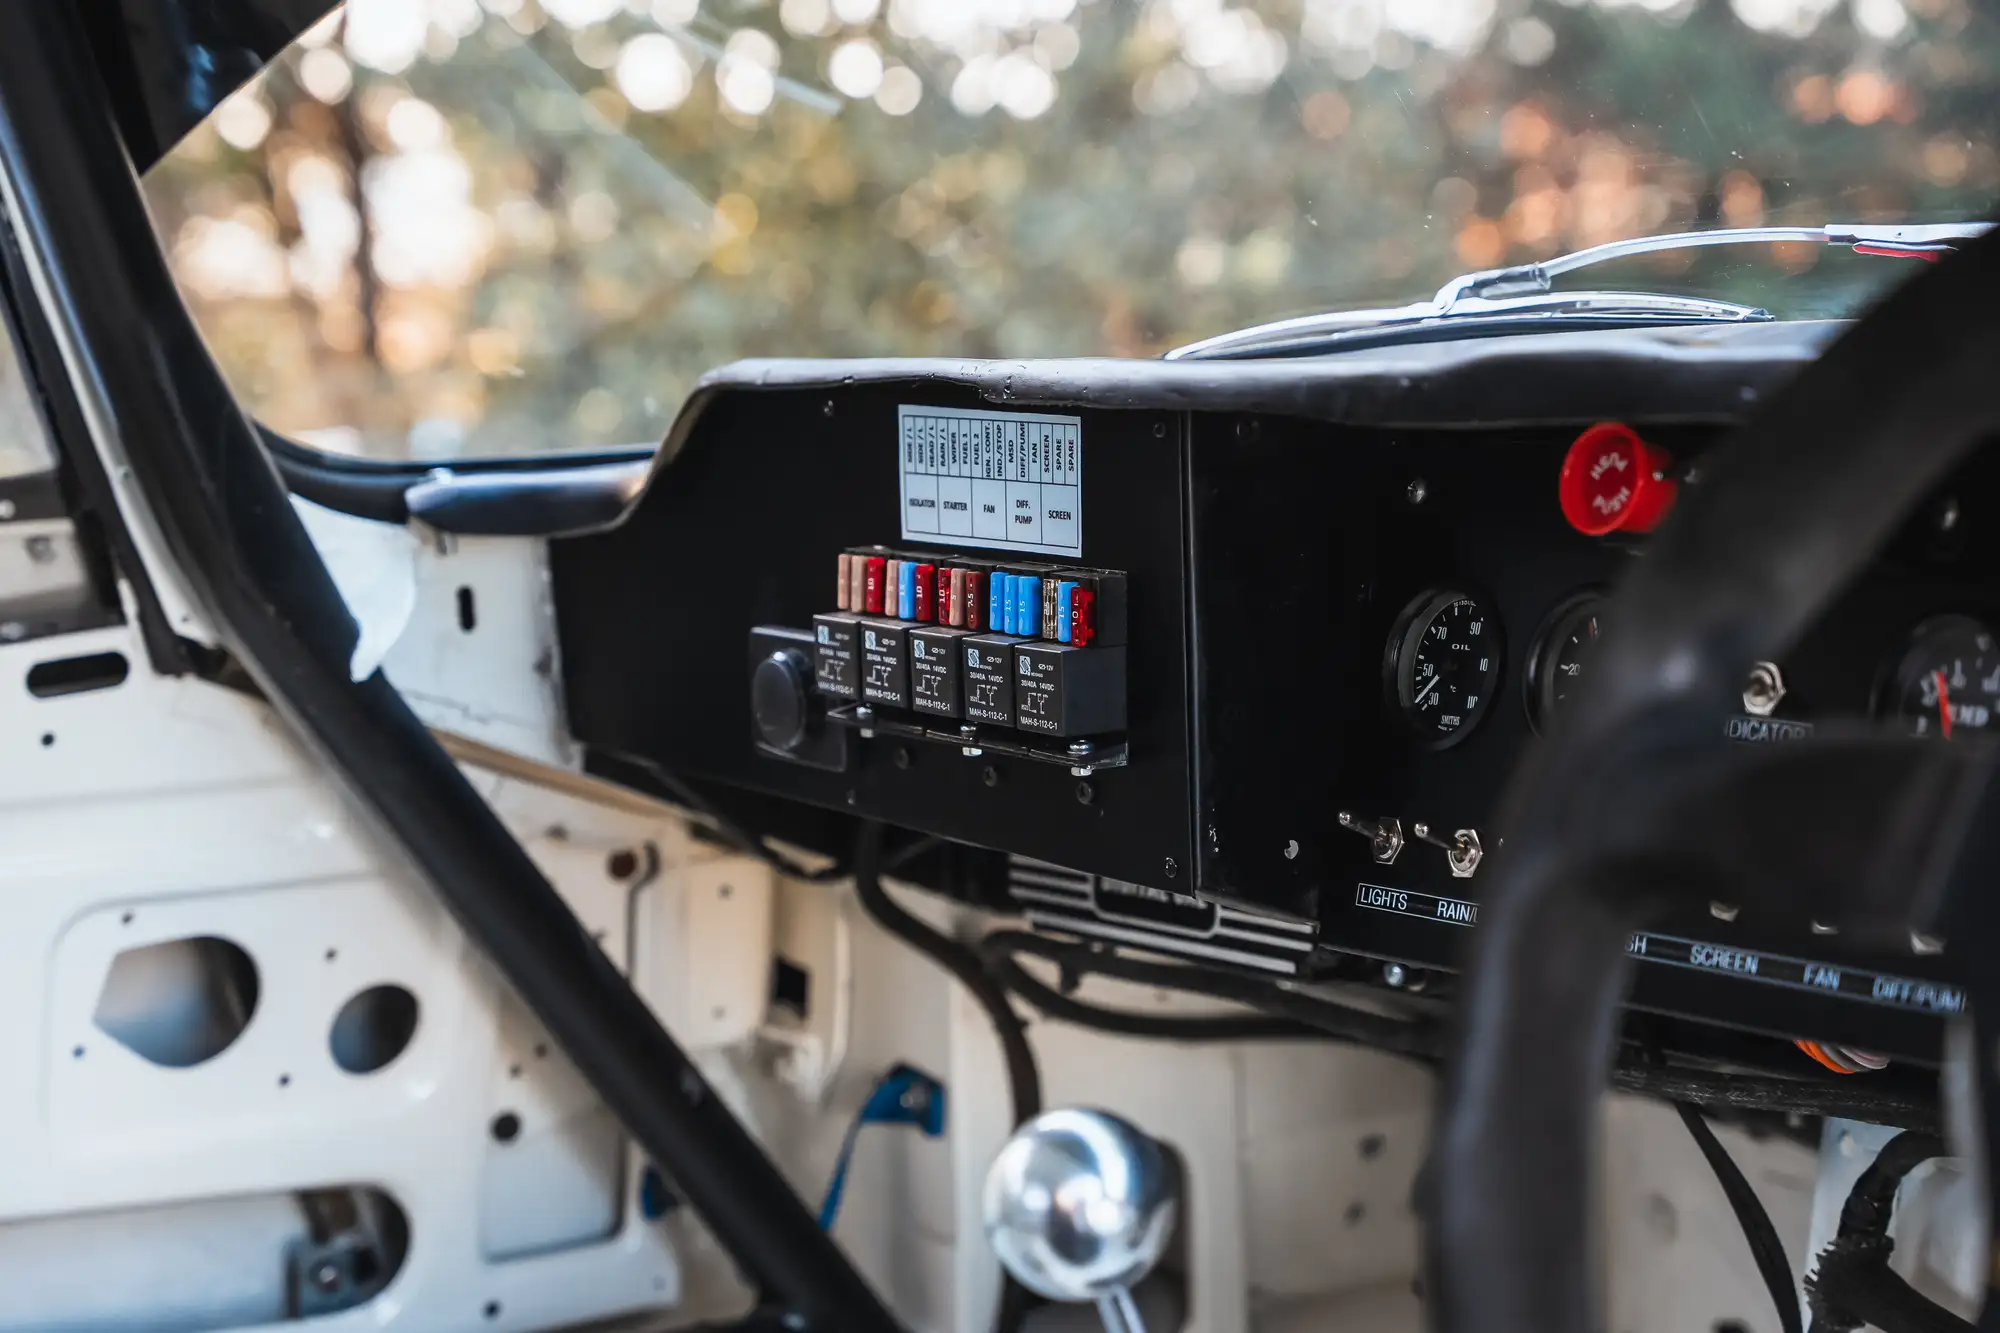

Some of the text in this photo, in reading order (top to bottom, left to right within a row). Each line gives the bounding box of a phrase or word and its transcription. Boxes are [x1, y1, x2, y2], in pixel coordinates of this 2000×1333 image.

[909, 498, 936, 508] ISOLATOR
[943, 500, 968, 511] STARTER
[983, 504, 995, 514] FAN
[1016, 499, 1031, 510] DIFF.
[1014, 515, 1033, 525] PUMP
[1048, 509, 1072, 521] SCREEN
[867, 578, 875, 591] 10
[916, 585, 923, 599] 10
[939, 590, 946, 603] 10
[991, 595, 998, 607] 15
[1005, 599, 1012, 612] 15
[1019, 600, 1026, 613] 15
[1058, 606, 1065, 619] 15
[1436, 626, 1448, 640] 70
[1470, 621, 1482, 636] 90
[1451, 643, 1471, 651] OIL
[1422, 664, 1434, 677] 50
[1568, 663, 1581, 676] 20
[969, 671, 1004, 683] 30/40A 14VDC
[1020, 679, 1055, 692] 30/40A 14VDC
[915, 697, 951, 712] MAH-S-112-C-1
[1428, 692, 1439, 706] 30
[968, 707, 1007, 721] MAH-S-112-C-1
[1440, 715, 1460, 726] SMITHS
[1020, 716, 1058, 730] MAH-S-112-C-1
[1360, 887, 1408, 910] LIGHTS
[1689, 944, 1758, 975] SCREEN
[1803, 964, 1841, 990] FAN
[1873, 976, 1966, 1012] DIFF/PUM
